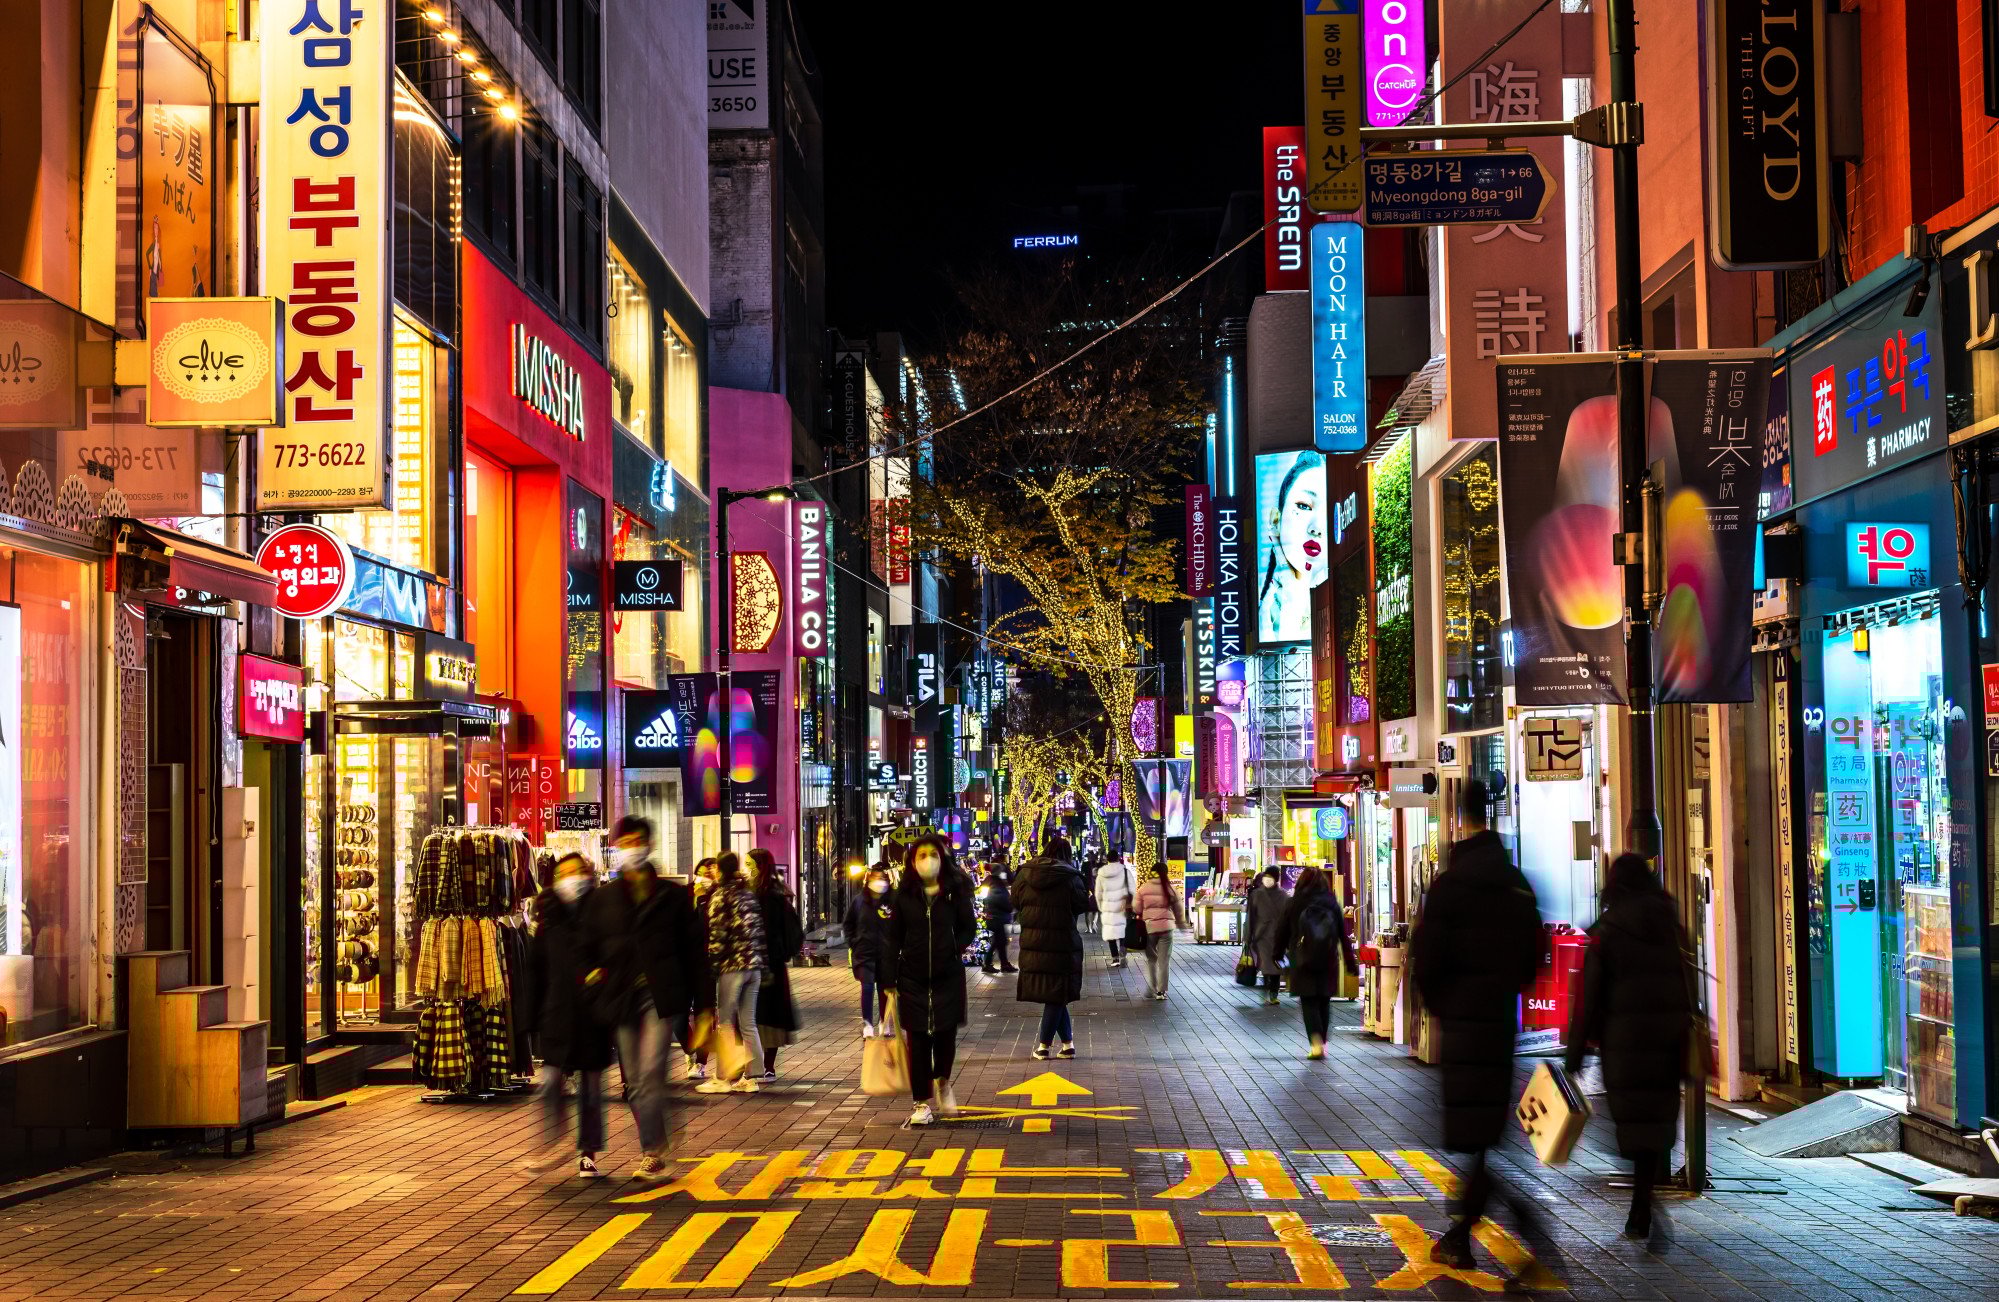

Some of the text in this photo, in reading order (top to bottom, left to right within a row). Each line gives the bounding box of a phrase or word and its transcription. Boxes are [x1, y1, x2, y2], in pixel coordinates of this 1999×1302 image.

[1741, 32, 1755, 140] THE GIFT
[1276, 145, 1299, 181] the
[1370, 160, 1463, 185] 명동8가길
[1519, 167, 1533, 179] 66
[162, 173, 196, 225] かばん
[1371, 188, 1467, 206] Myeongdong
[1471, 186, 1523, 202] 8ga-gil
[1014, 235, 1078, 248] FERRUM
[1327, 236, 1348, 398] MOON HAIR
[512, 322, 585, 442] MISSHA
[1323, 413, 1356, 424] SALON
[1323, 425, 1358, 435] 752-0368
[1881, 416, 1931, 458] PHARMACY
[274, 442, 366, 469] 773-6622
[1193, 493, 1203, 511] The
[275, 543, 318, 565] 노정석
[1218, 508, 1239, 585] HOLIKA
[271, 566, 341, 598] 형외과
[799, 507, 822, 650] BANILA CO
[1194, 571, 1203, 591] Skin
[620, 592, 674, 605] MISSHA
[917, 653, 935, 702] FILA
[994, 659, 1005, 687] AHC
[1830, 715, 1864, 750] 약
[913, 748, 928, 808] swatch
[1830, 777, 1869, 786] Pharmacy
[1837, 794, 1864, 822] 药
[1233, 838, 1253, 850] 1+1
[1834, 847, 1870, 858] Ginseng
[1836, 883, 1856, 897] 1F
[1782, 862, 1796, 1055] 비수술적 탈모치료
[1528, 998, 1556, 1011] SALE
[609, 1147, 1466, 1204] 차없는 거리
